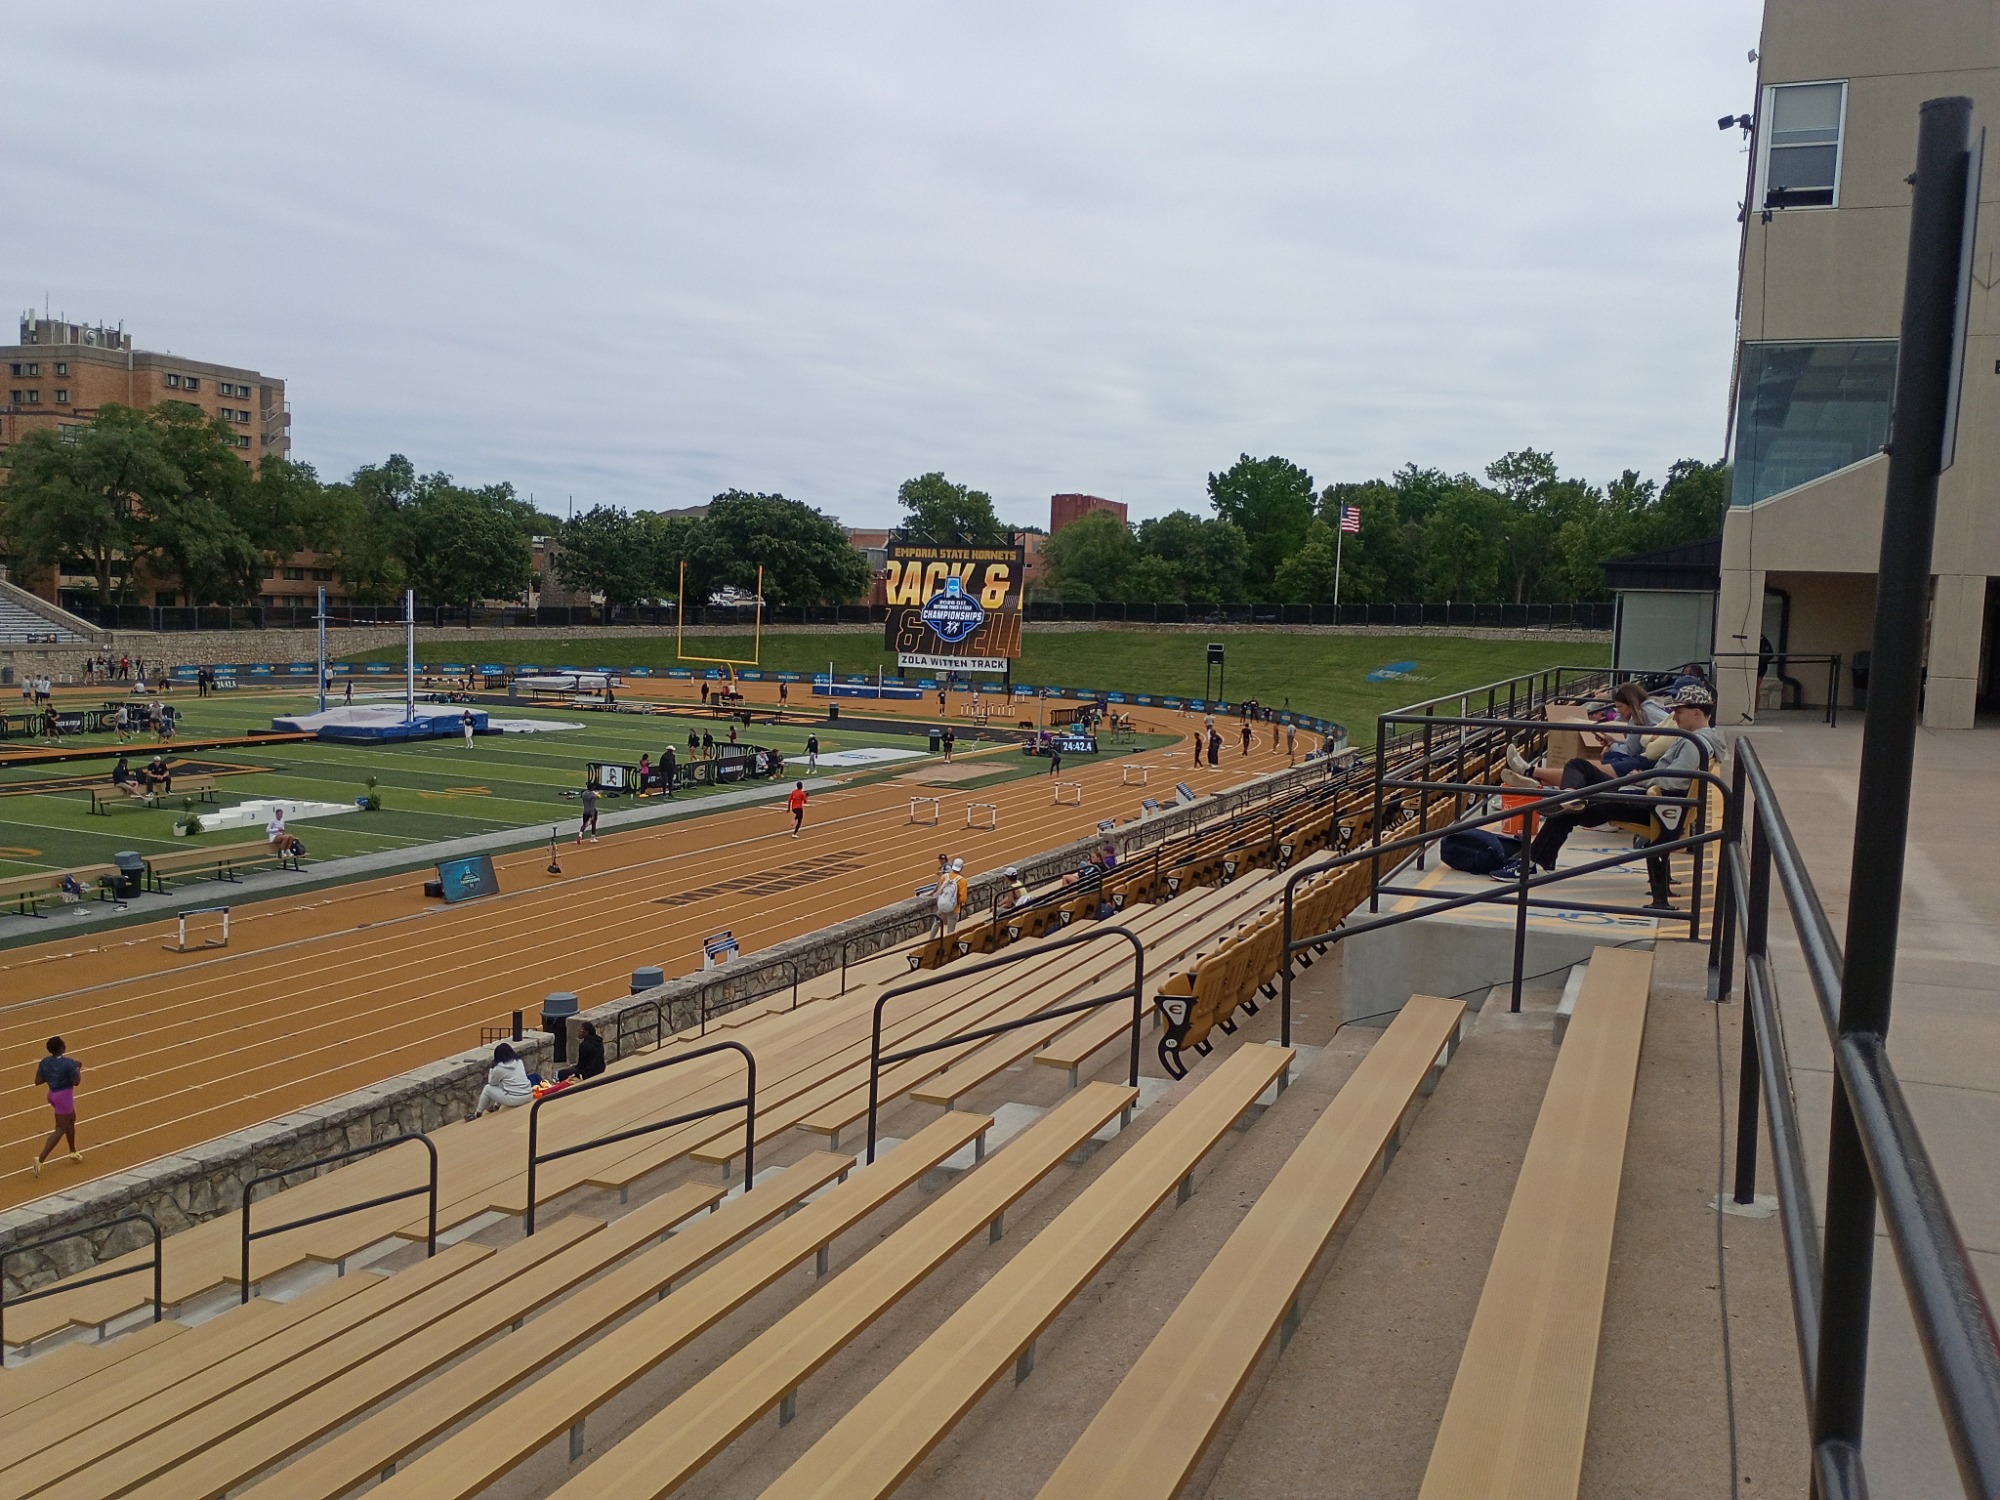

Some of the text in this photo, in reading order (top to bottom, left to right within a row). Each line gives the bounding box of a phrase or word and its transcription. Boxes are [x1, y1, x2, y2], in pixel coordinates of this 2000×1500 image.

[895, 547, 1017, 561] EMPORIA STATE HORNETS
[980, 563, 1010, 609] &
[923, 610, 982, 621] CHAMPIONSHIPS
[901, 655, 1004, 669] ZOLA WITTEN TRACK
[1062, 741, 1092, 751] 24:42.4
[651, 850, 869, 906] EMPORIA STATE
[736, 862, 867, 897] HORNETS
